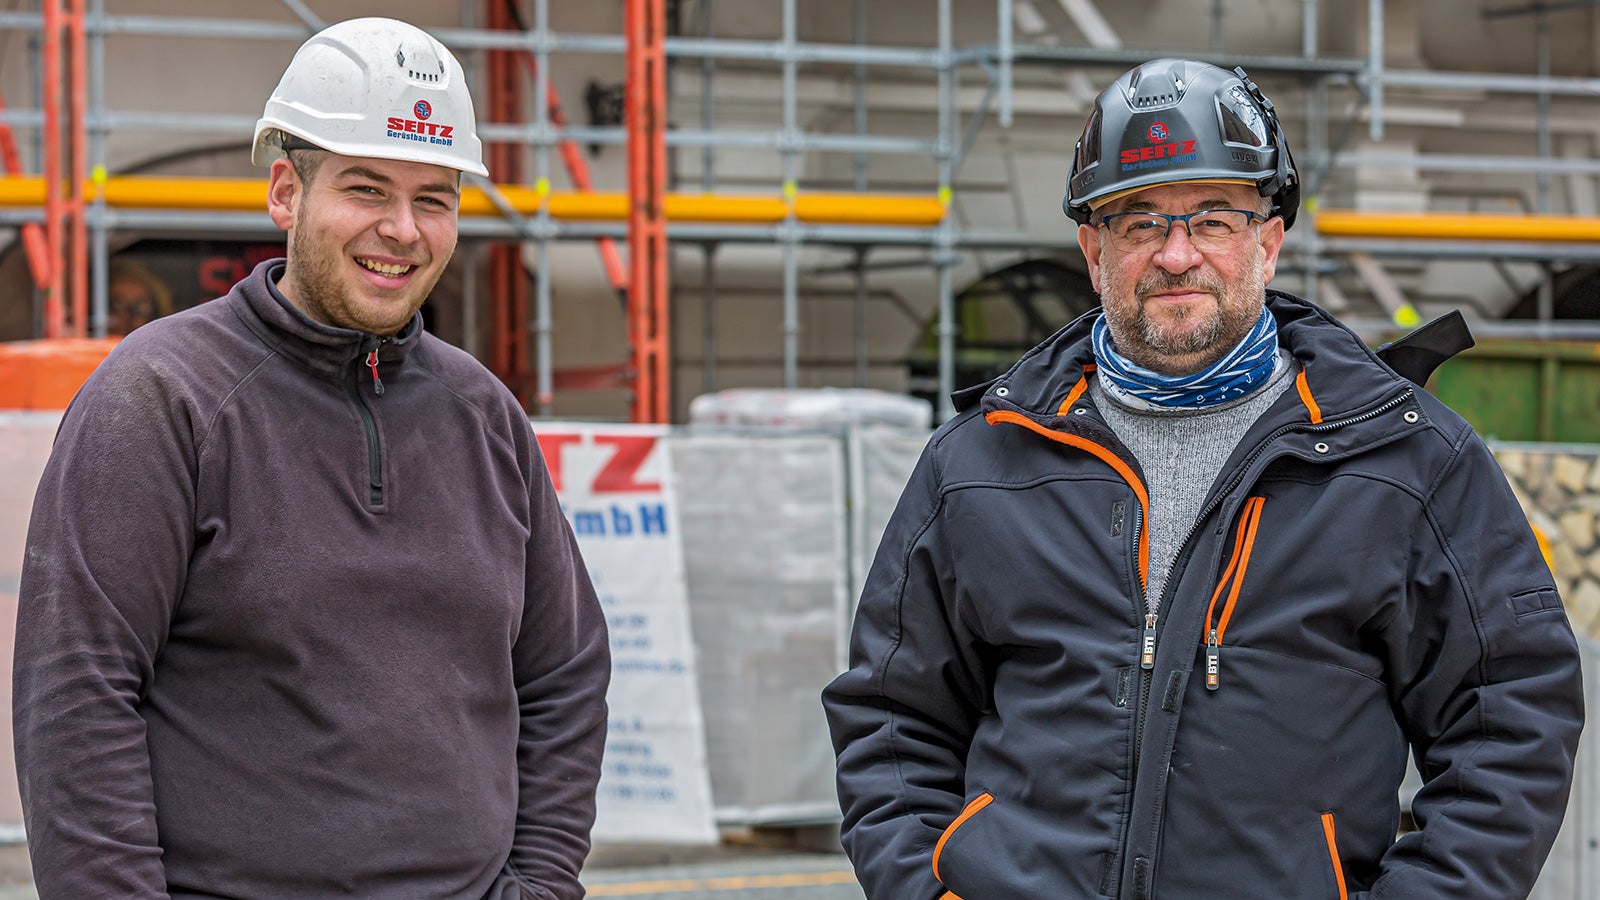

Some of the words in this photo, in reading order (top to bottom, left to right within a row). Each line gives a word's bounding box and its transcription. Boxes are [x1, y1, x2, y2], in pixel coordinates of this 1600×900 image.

[387, 117, 453, 138] SEITZ
[387, 129, 427, 142] Gerüstbau
[430, 136, 453, 146] GmbH
[1121, 140, 1196, 163] SEITZ
[562, 503, 667, 535] mbH
[1144, 636, 1154, 654] BTI
[1208, 655, 1217, 674] BTI
